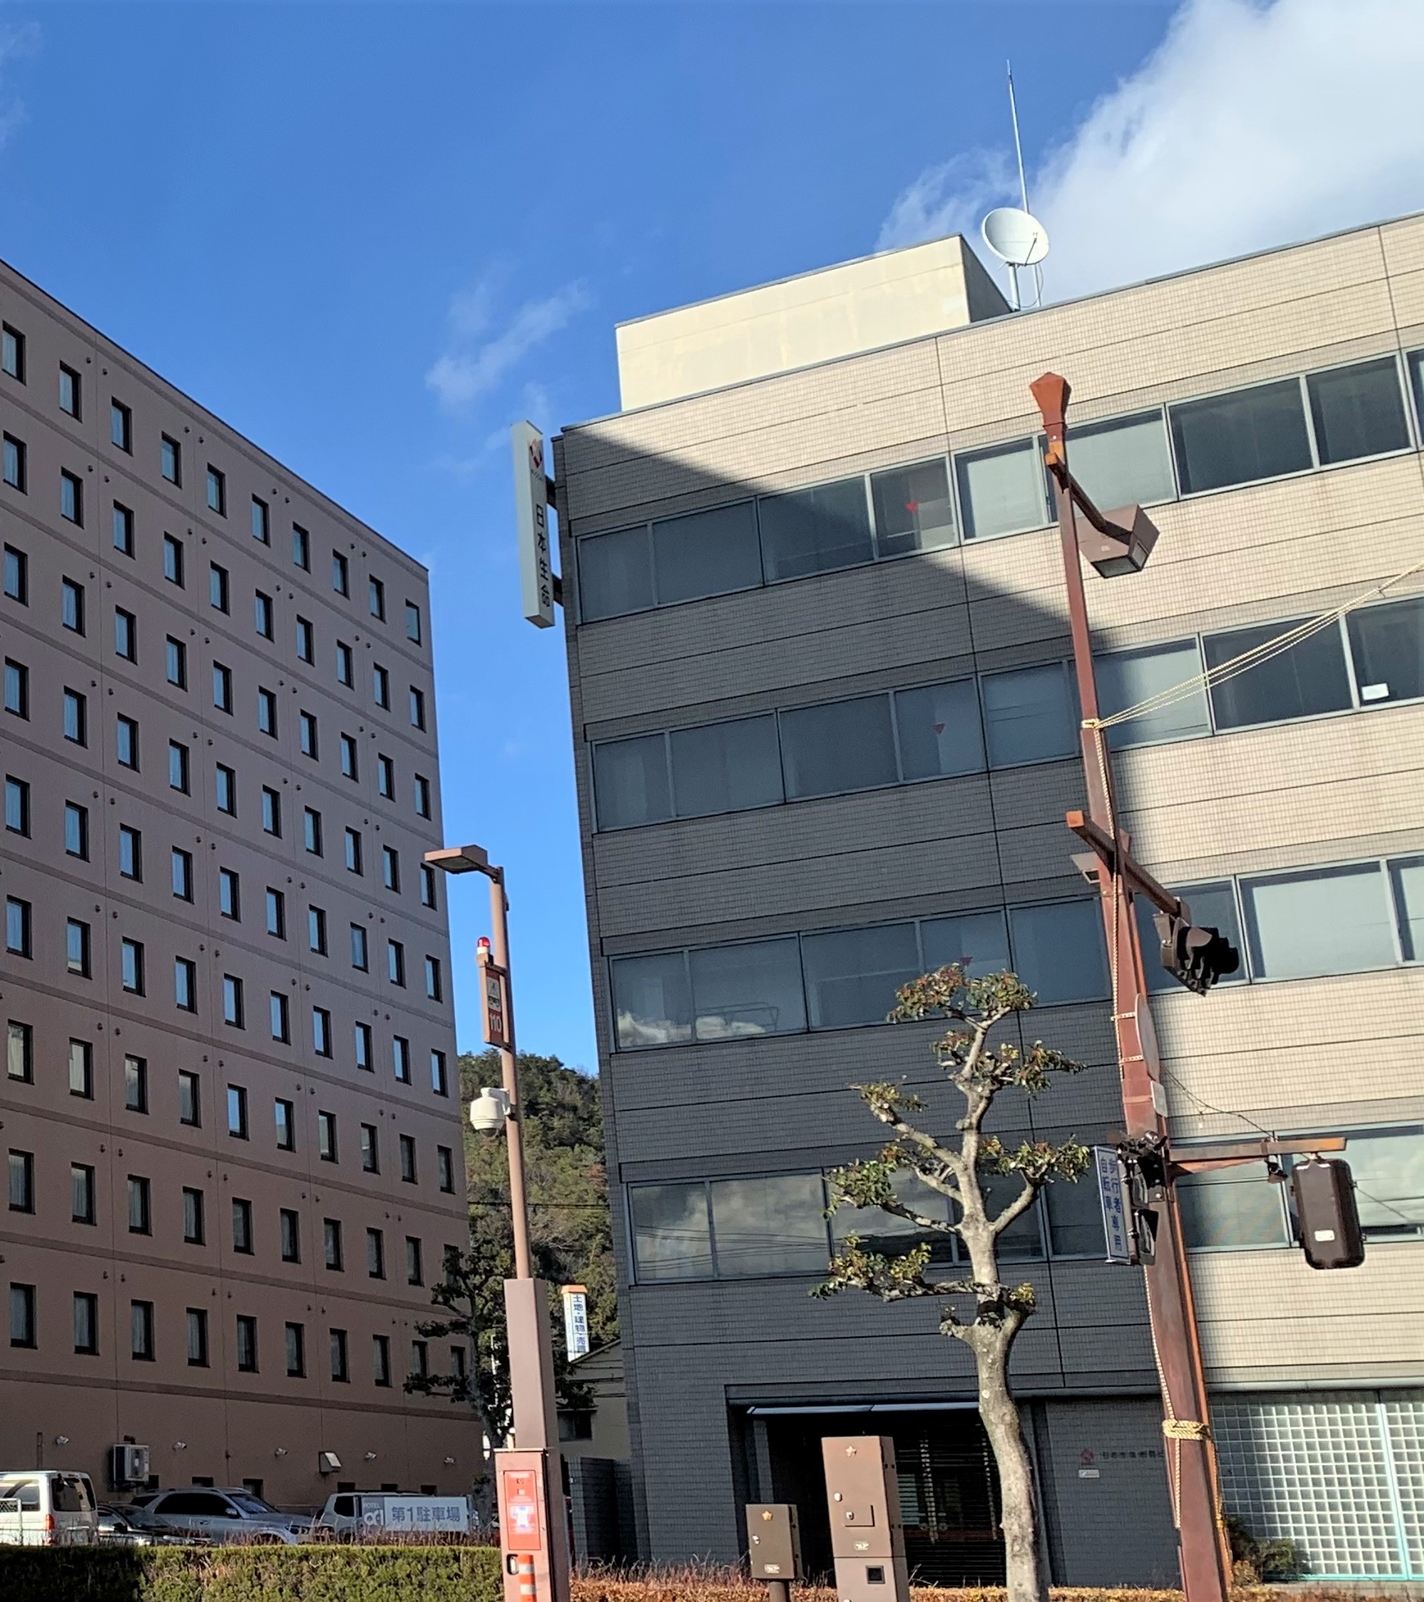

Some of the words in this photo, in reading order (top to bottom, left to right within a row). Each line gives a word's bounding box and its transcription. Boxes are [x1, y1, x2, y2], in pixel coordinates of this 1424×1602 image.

[537, 503, 550, 607] 日本生命
[392, 1506, 461, 1522] 第1駐車場
